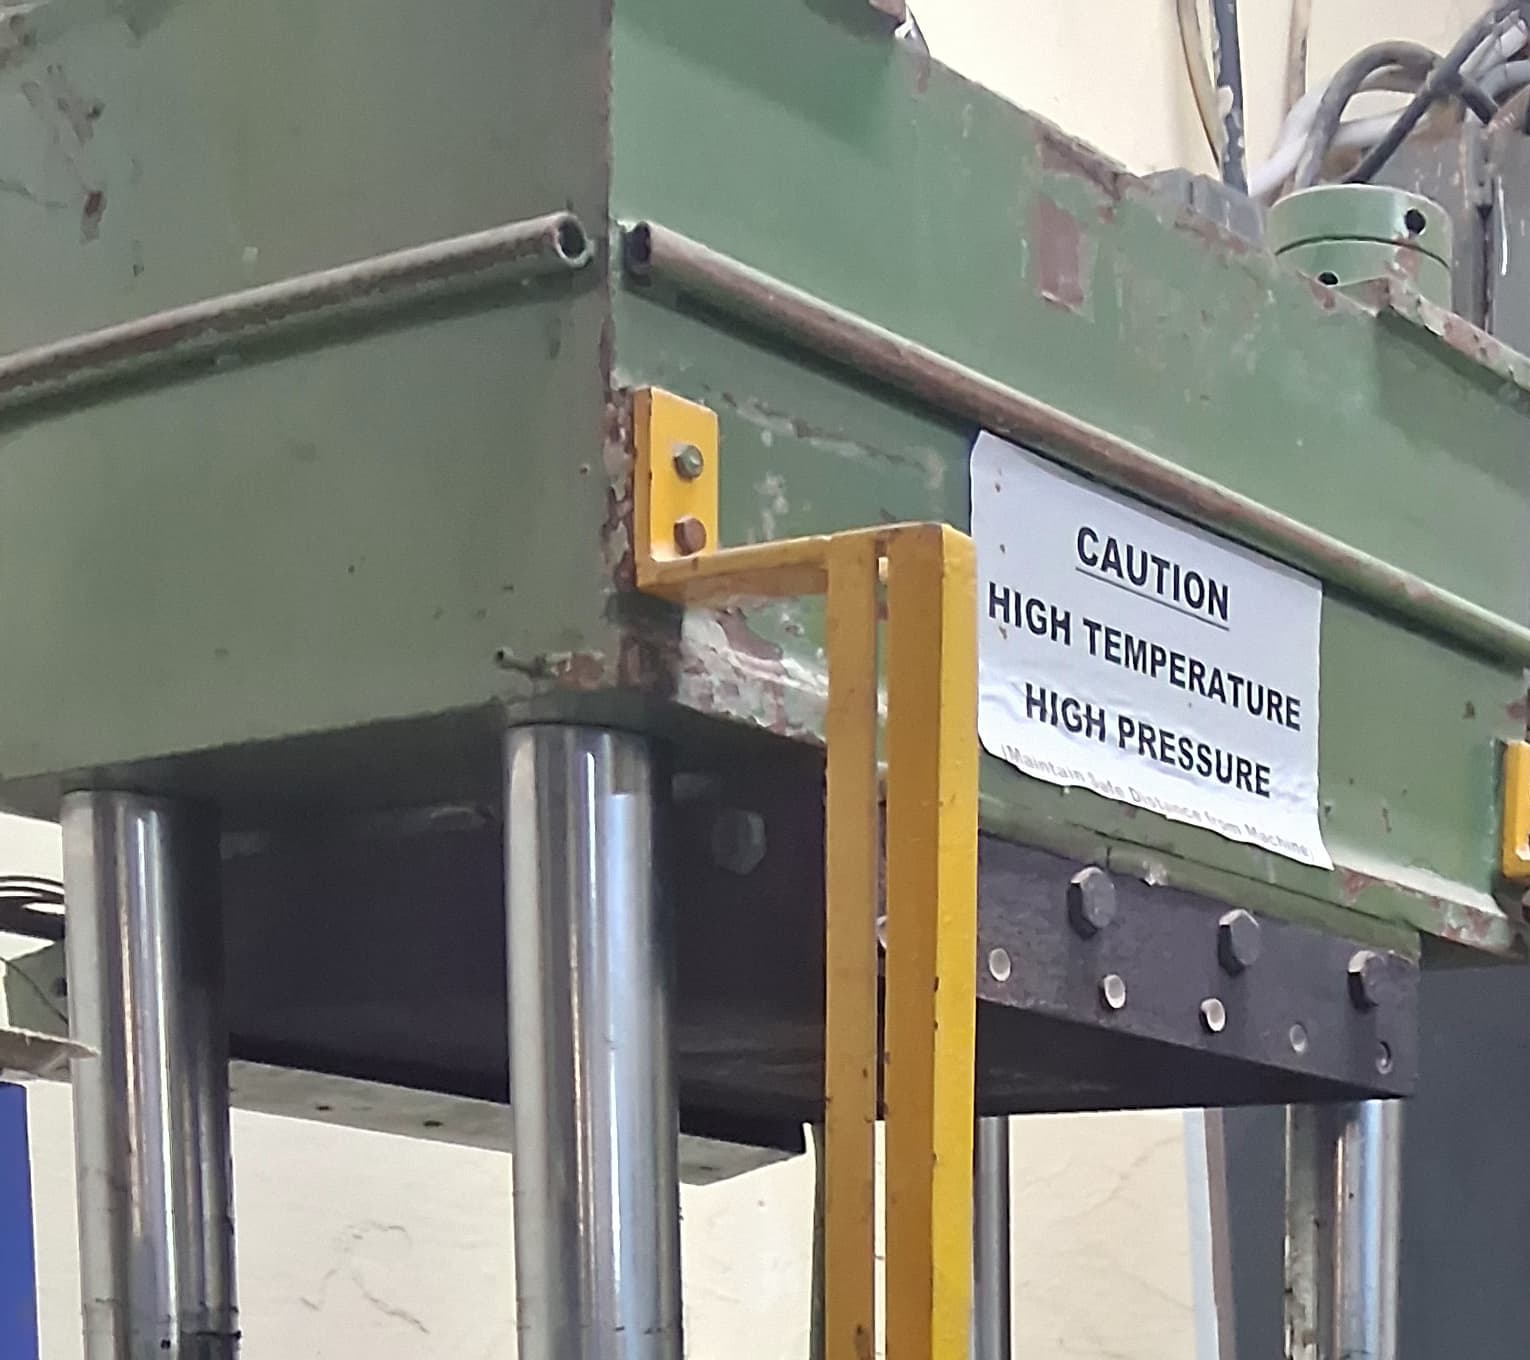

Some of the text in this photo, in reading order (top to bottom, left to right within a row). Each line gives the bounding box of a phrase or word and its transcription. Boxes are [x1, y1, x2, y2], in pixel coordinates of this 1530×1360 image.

[1076, 525, 1230, 622] CAUTION
[988, 580, 1302, 732] HIGH TEMPERATURE
[1025, 682, 1272, 799] HIGH PRESSURE
[1088, 772, 1126, 799] Safe
